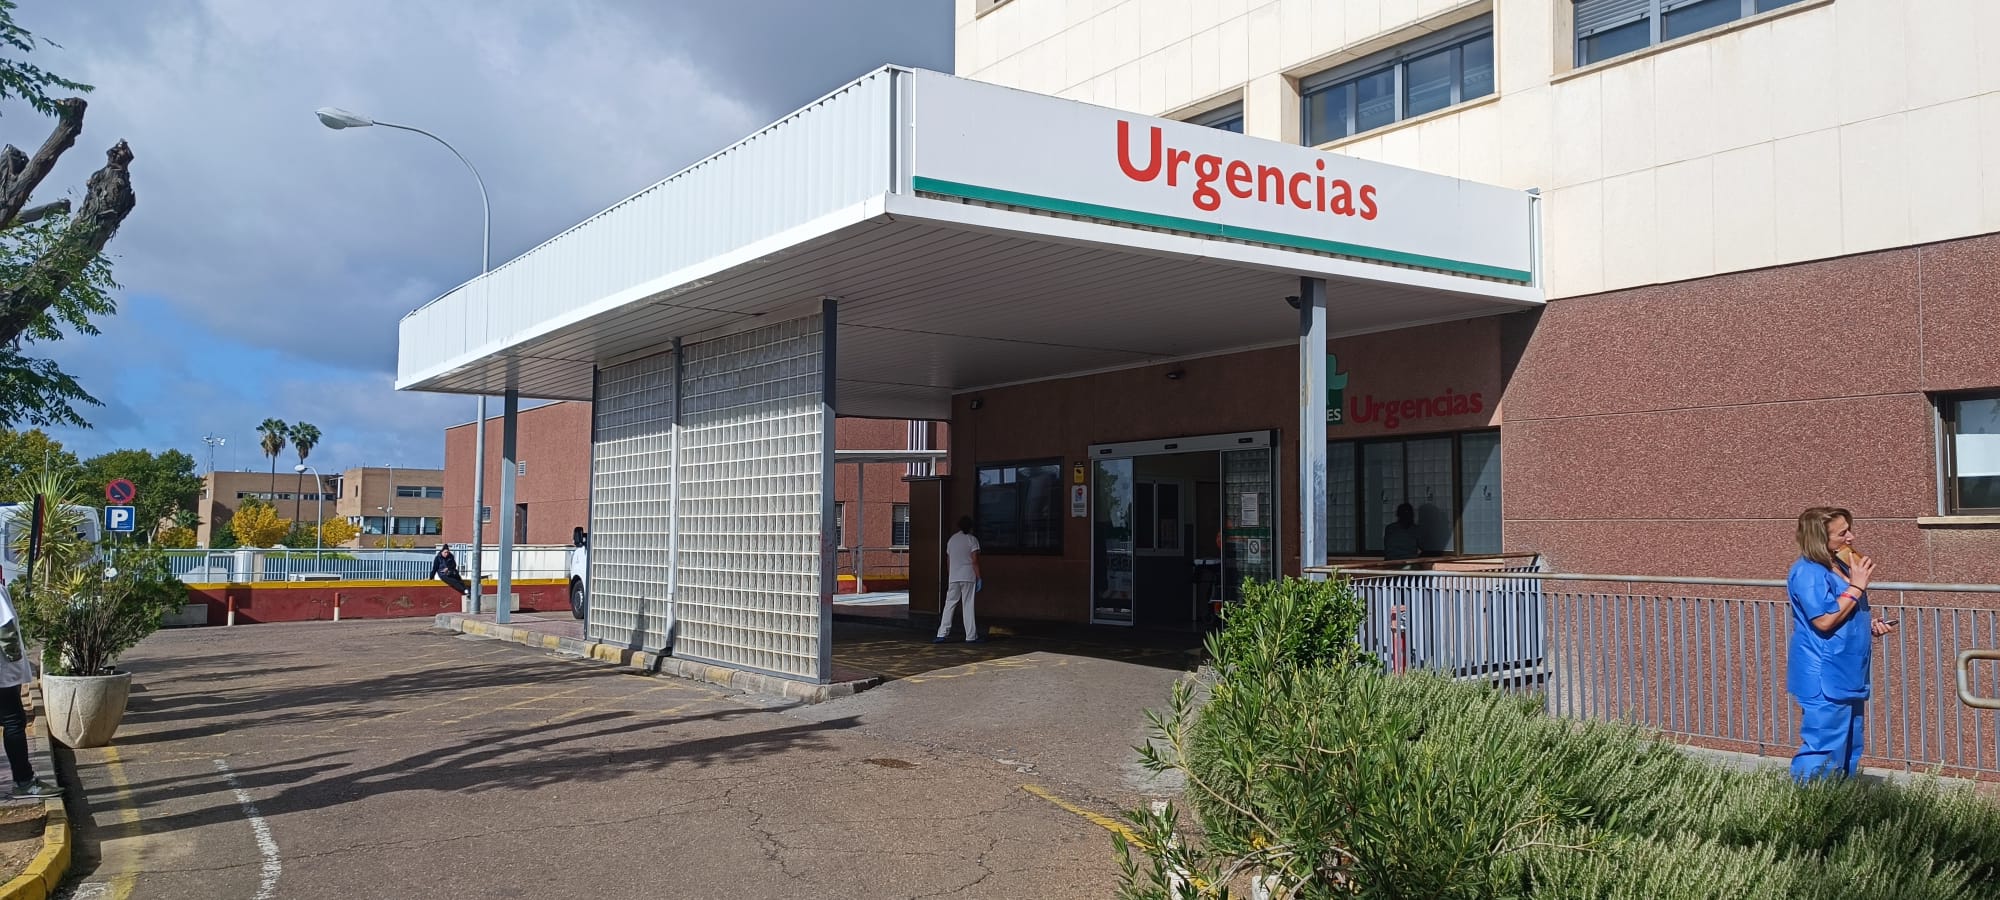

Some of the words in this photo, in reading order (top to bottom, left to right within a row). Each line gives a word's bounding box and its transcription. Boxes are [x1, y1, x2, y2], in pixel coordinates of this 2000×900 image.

[1117, 120, 1378, 221] Urgencias
[1327, 408, 1341, 422] ES
[1350, 389, 1483, 429] Urgencias
[111, 509, 129, 529] P
